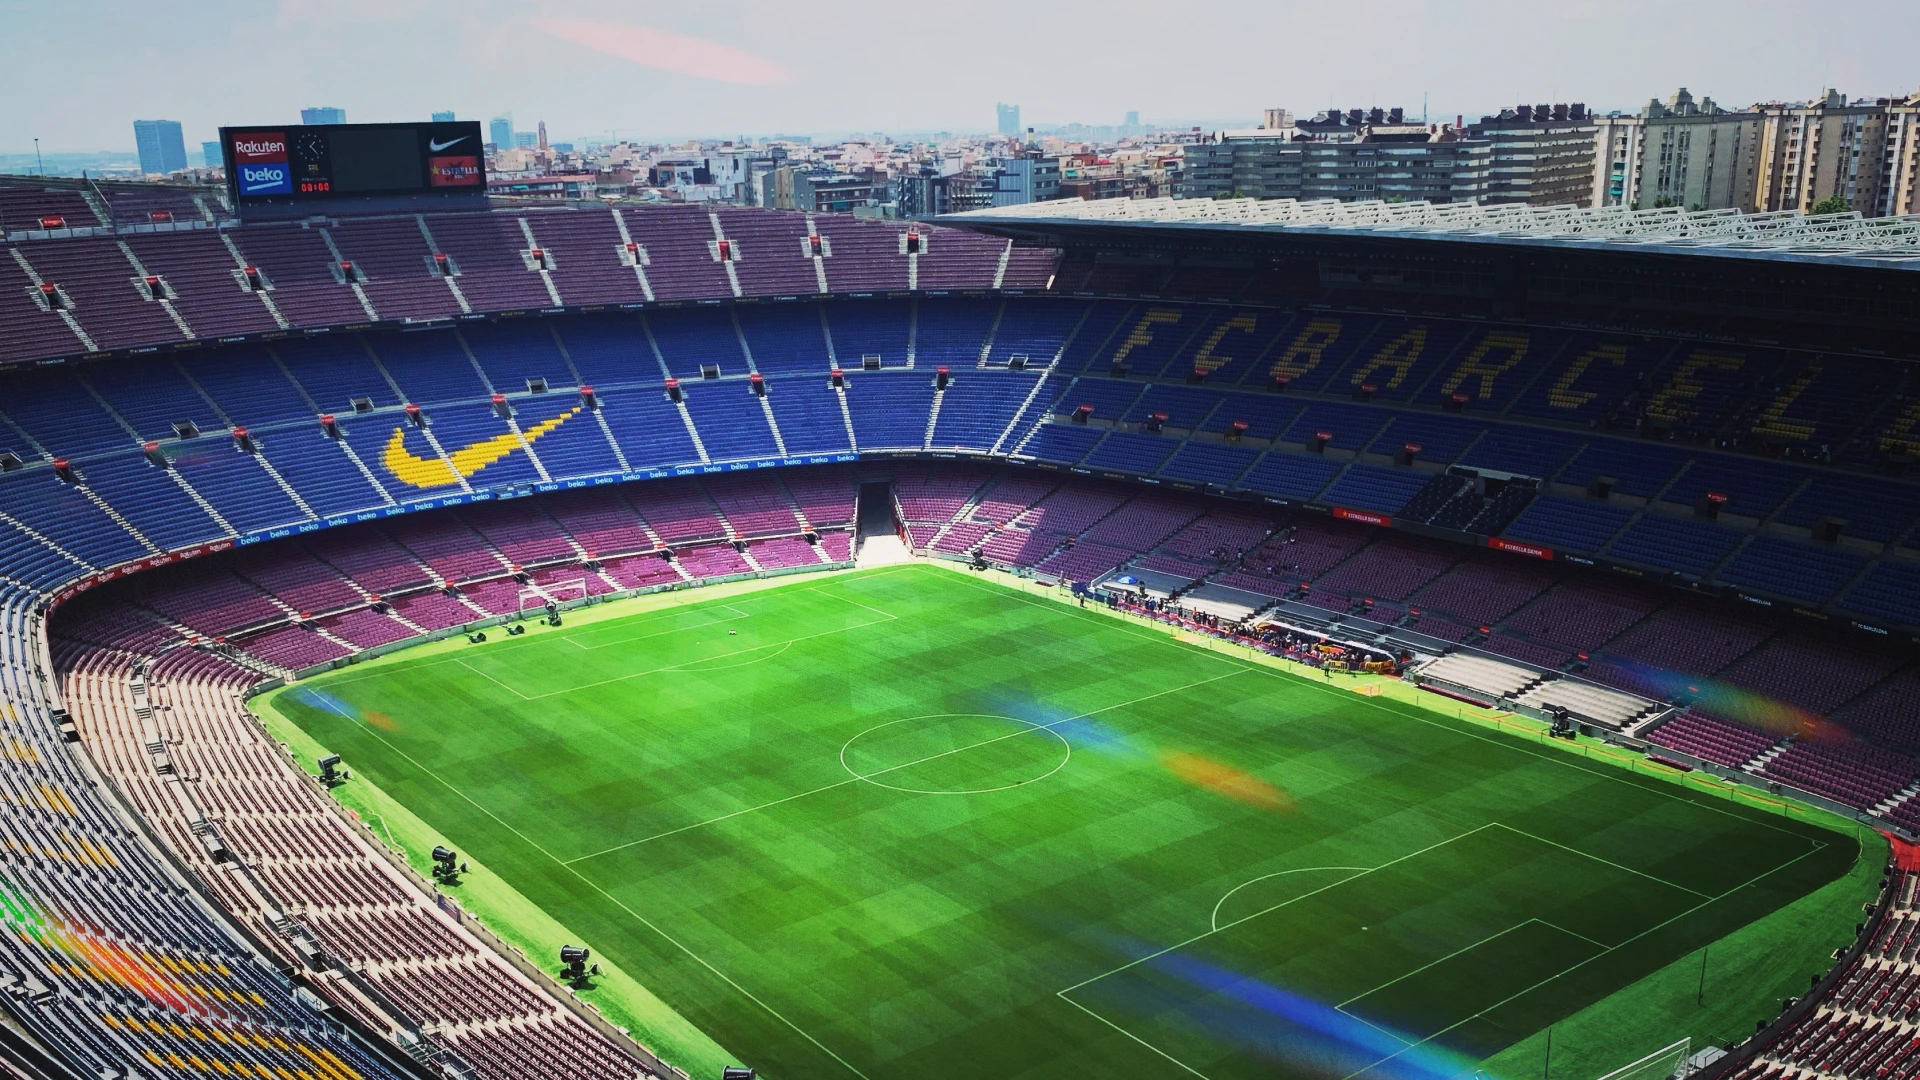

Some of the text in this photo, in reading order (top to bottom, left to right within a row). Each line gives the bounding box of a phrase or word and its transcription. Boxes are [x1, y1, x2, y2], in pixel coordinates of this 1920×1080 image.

[235, 140, 285, 154] Rakuten
[244, 167, 284, 182] beko
[441, 166, 479, 176] ESTRELLA
[301, 182, 330, 193] 00:00
[784, 458, 801, 466] beko
[810, 456, 828, 464] beko
[837, 454, 854, 462] beko
[704, 465, 722, 473] beko
[731, 462, 748, 471] beko
[757, 460, 775, 468] beko
[649, 471, 667, 479] beko
[677, 468, 694, 476] beko
[595, 476, 613, 485] beko
[622, 473, 640, 482] beko
[539, 483, 558, 492] beko
[567, 480, 586, 489] beko
[443, 497, 462, 506] beko
[471, 492, 490, 502] beko
[385, 506, 405, 516] beko
[414, 501, 433, 511] beko
[357, 511, 376, 521] beko
[328, 517, 347, 527] beko
[299, 523, 318, 533] beko
[270, 529, 289, 539] beko
[241, 535, 260, 545] beko
[210, 541, 231, 552] Rakuten
[1505, 543, 1542, 556] ESTRELLA DAMM
[180, 548, 201, 559] Rakuten
[150, 556, 172, 567] Rakuten
[122, 564, 142, 574] Rakuten
